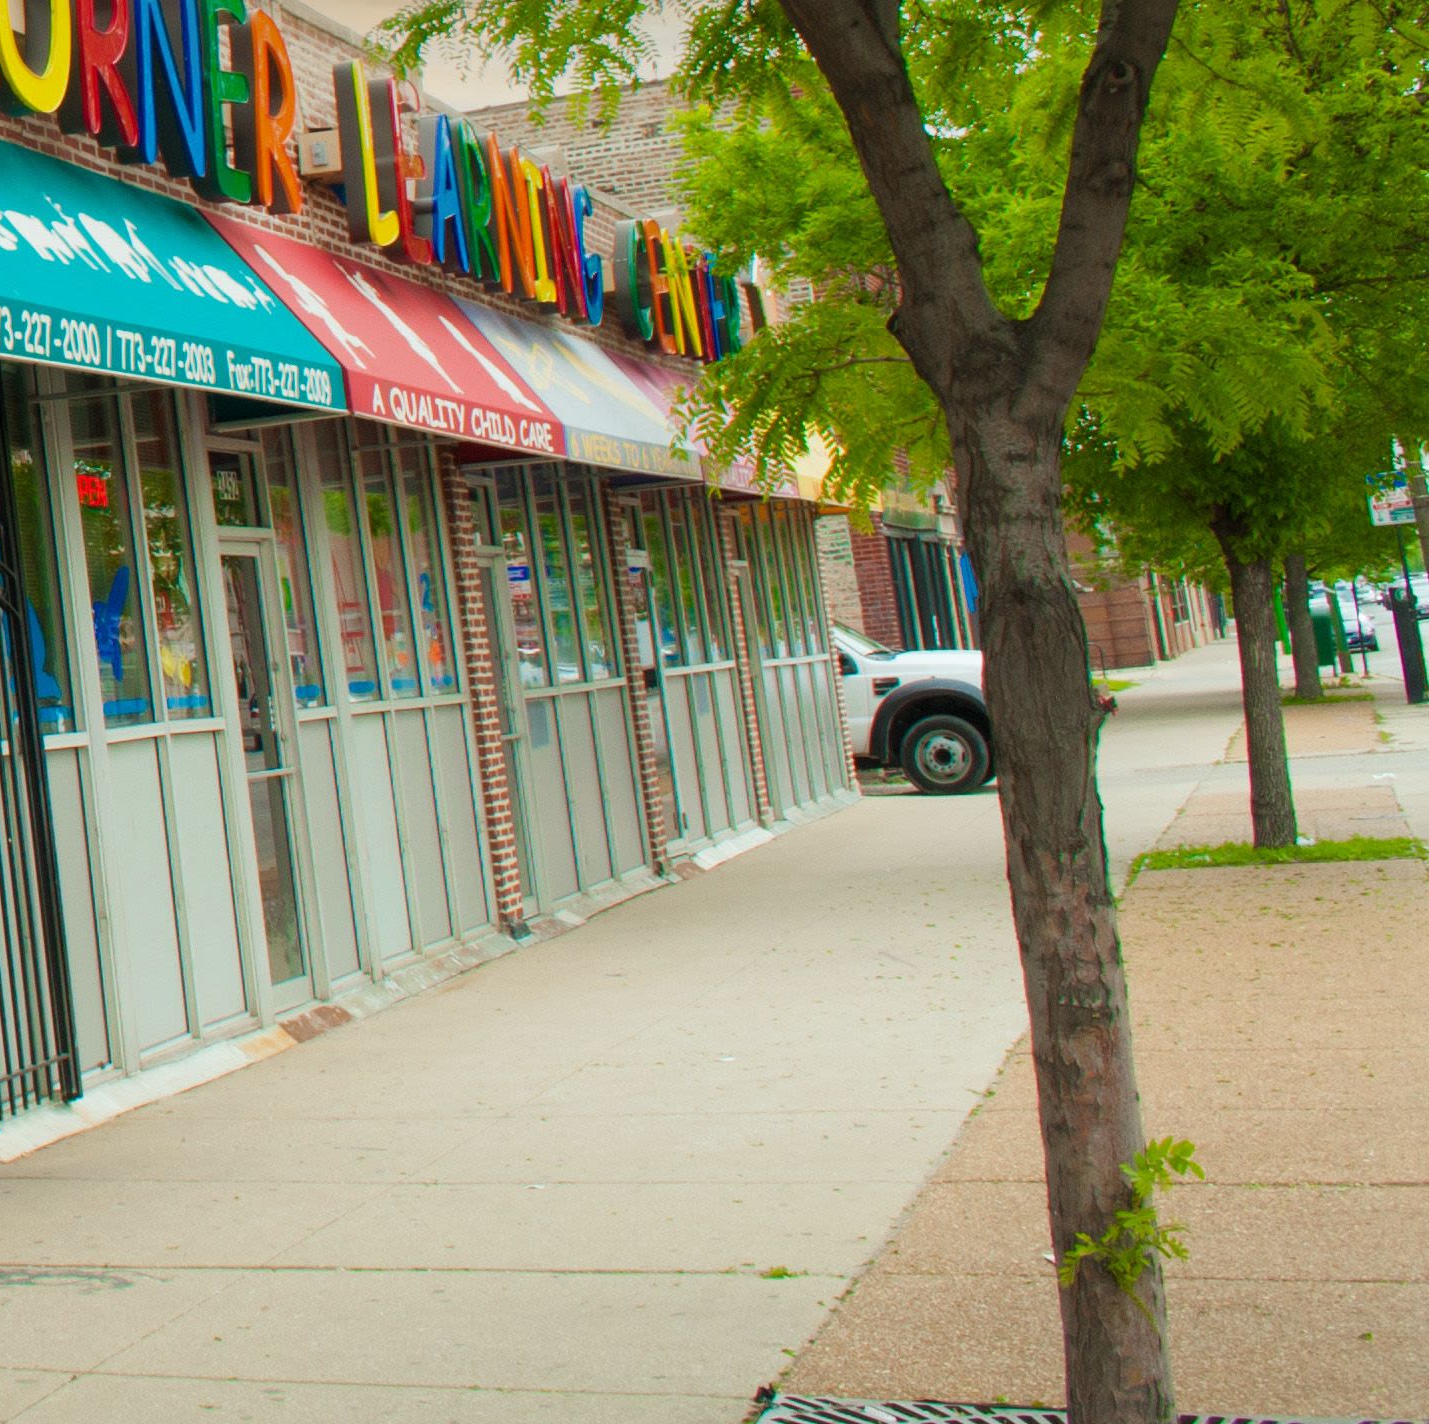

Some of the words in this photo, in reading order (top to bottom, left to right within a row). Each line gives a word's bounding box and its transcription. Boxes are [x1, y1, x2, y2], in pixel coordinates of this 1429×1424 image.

[337, 58, 603, 326] LEARNING
[116, 329, 217, 385] 773-227-2003
[372, 387, 385, 413] A
[389, 387, 465, 436] QUALITY
[470, 406, 516, 445] CHILD
[518, 420, 554, 454] CARE
